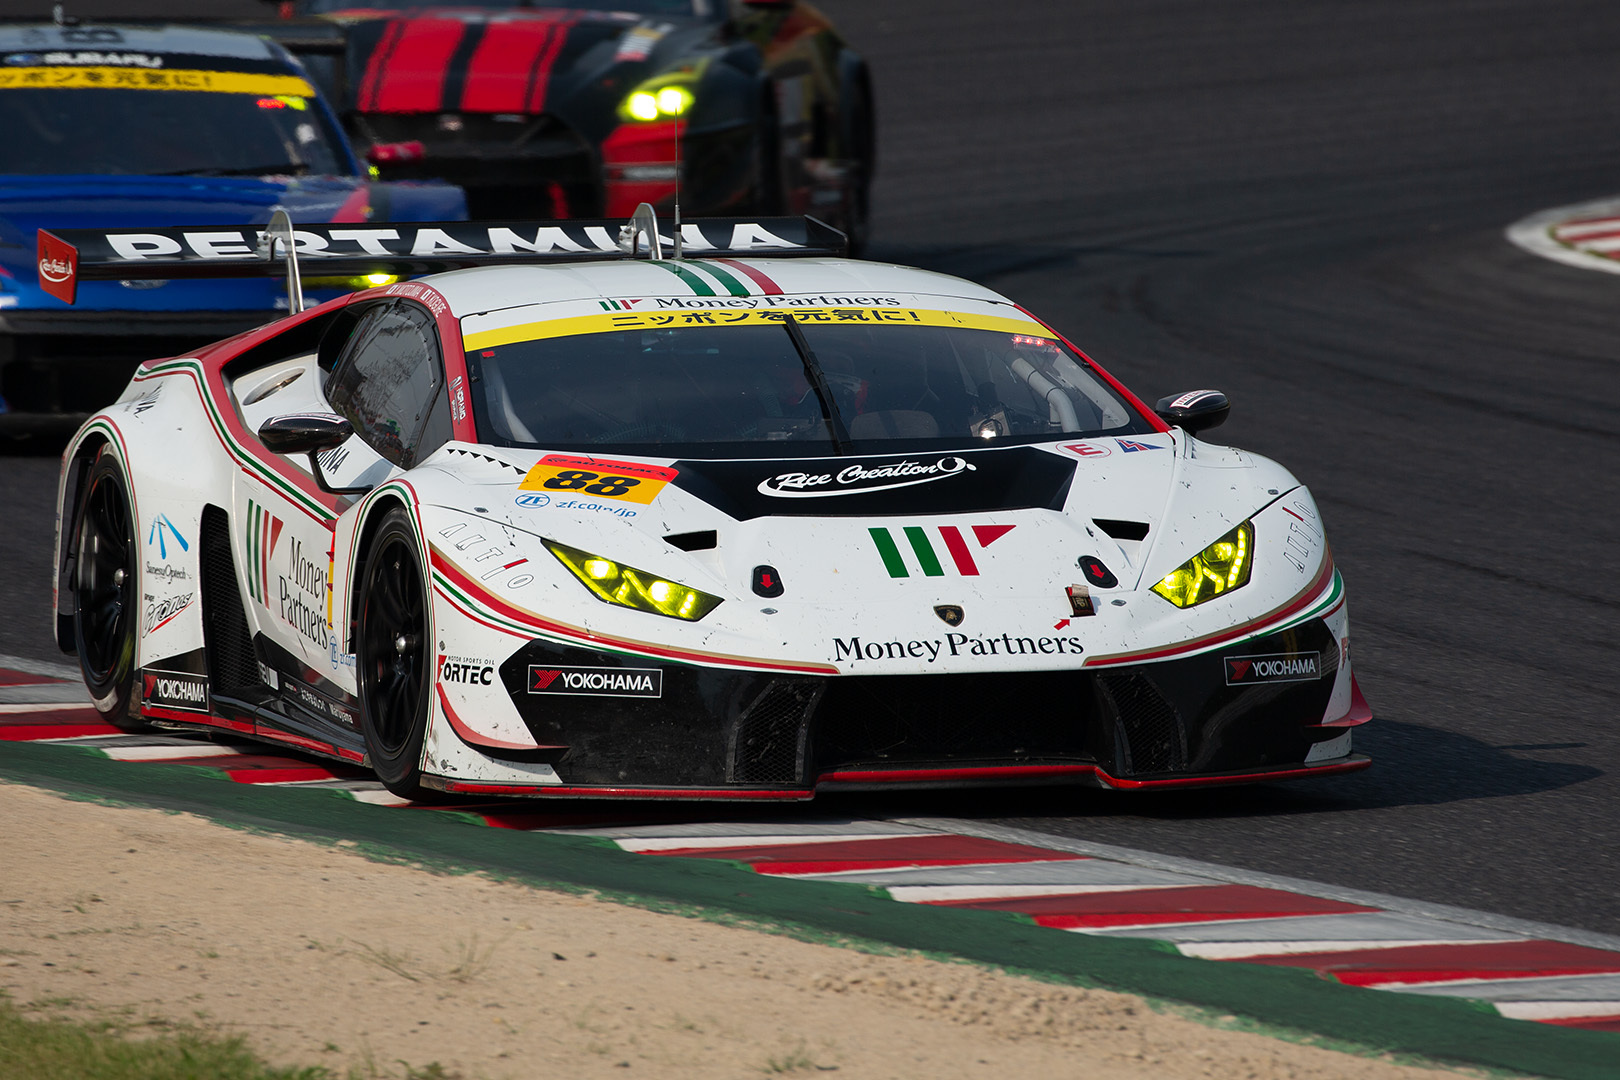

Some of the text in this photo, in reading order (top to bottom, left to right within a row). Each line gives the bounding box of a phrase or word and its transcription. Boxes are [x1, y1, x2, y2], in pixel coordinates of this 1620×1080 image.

[44, 52, 163, 68] SUBARU
[105, 222, 807, 260] PERTAMINA
[653, 294, 901, 309] Money Partners
[543, 470, 642, 496] 88
[775, 472, 832, 491] Rice
[518, 495, 547, 506] ZF
[288, 536, 328, 611] Money
[279, 574, 328, 650] Partners
[832, 632, 1084, 663] Money Partners
[437, 654, 494, 686] FORTEC
[463, 656, 482, 664] SPORTS
[484, 658, 495, 666] OIL
[1252, 658, 1316, 677] YOKOHAMA
[157, 678, 206, 702] YOKOHAMA
[562, 672, 654, 691] YOKOHAMA
